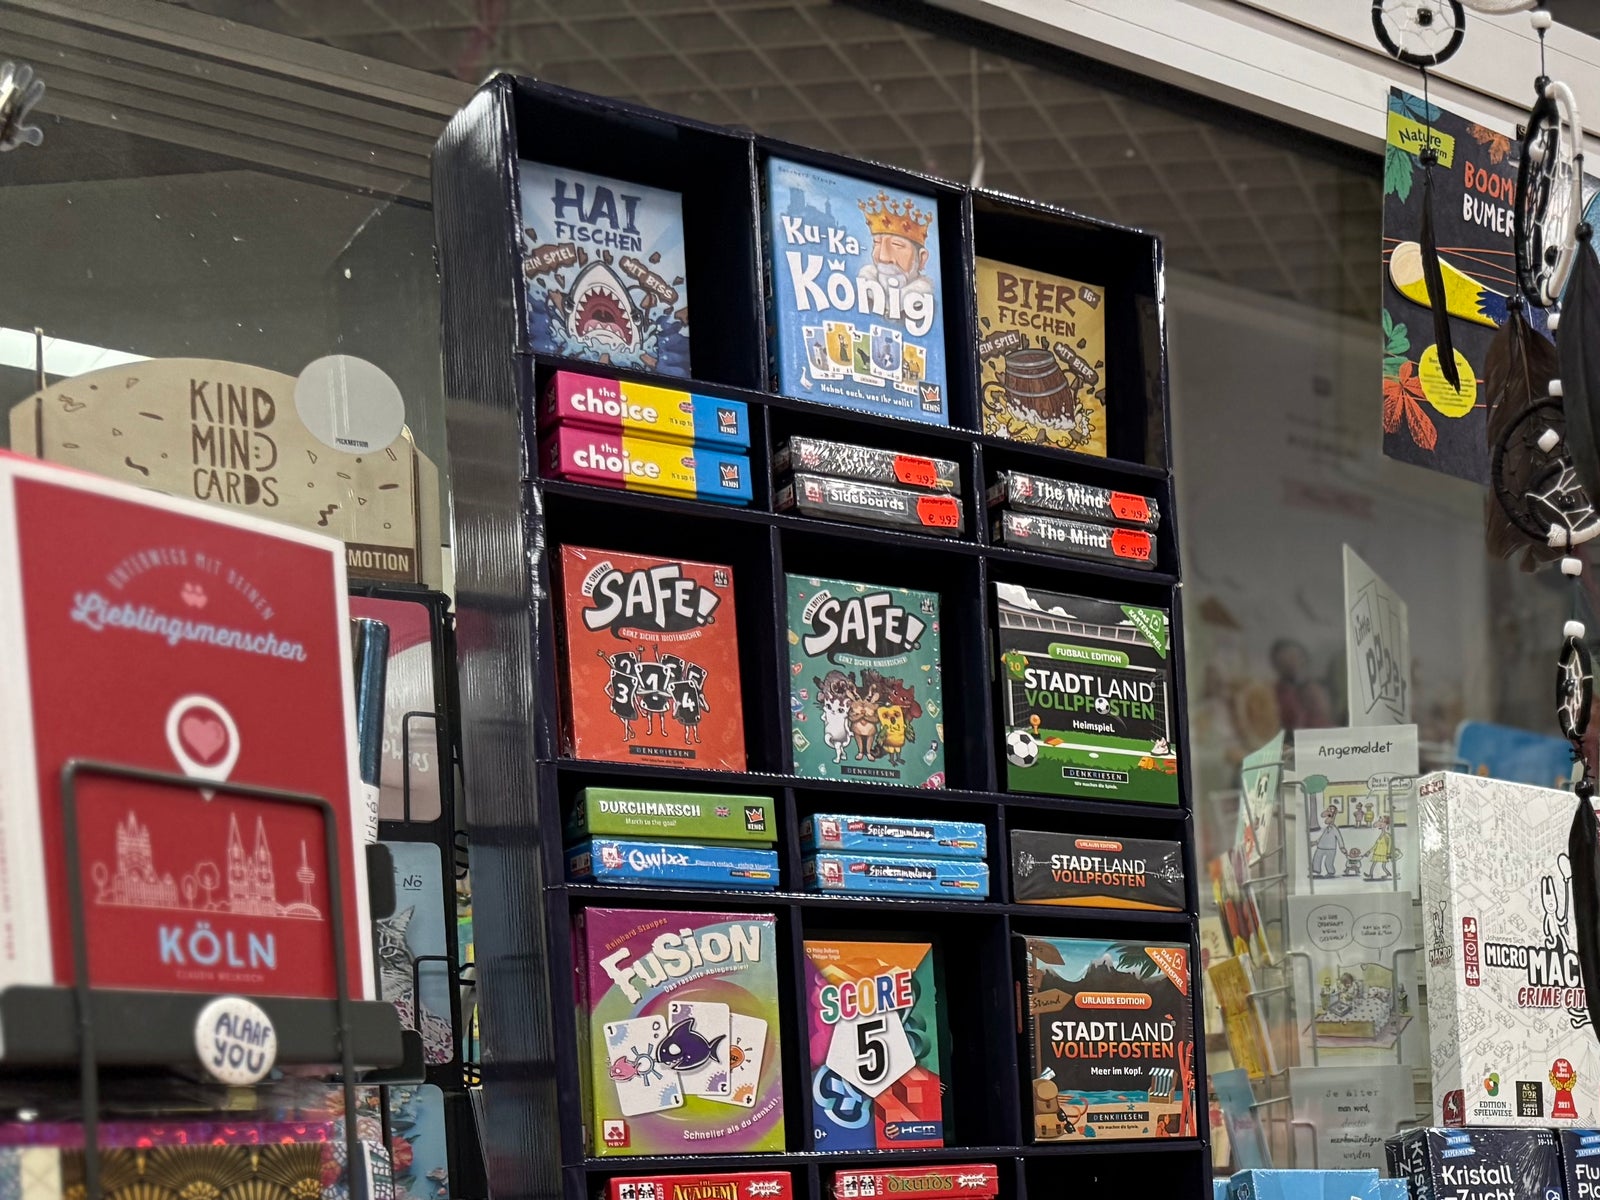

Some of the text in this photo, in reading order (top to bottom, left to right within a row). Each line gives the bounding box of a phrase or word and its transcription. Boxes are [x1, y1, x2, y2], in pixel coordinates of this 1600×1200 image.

[552, 178, 642, 236] HAI
[554, 221, 642, 251] FISCHEN
[781, 215, 867, 256] Ku-Ka-
[525, 247, 575, 272] EIN SPIEL
[622, 257, 673, 300] MIT BISS
[786, 251, 934, 337] König
[996, 272, 1076, 317] BIER
[999, 306, 1076, 337] FISCHEN
[979, 334, 1019, 354] EIN SPIEL
[1055, 343, 1095, 379] MIT BIER
[190, 379, 275, 429] KIND
[599, 387, 616, 398] the
[821, 383, 913, 409] Nehmt euch, was ihr wollt!
[570, 389, 659, 423] choice
[194, 468, 279, 507] CARDS
[831, 490, 905, 511] Sideboards
[1038, 523, 1107, 548] The Mind
[107, 549, 274, 621] UNTERWEGS MIT DEINEN
[583, 564, 721, 632] SAFE!
[70, 591, 307, 662] Lieblingsmenschen
[1091, 651, 1122, 664] EDITION
[1024, 668, 1155, 702] STADT LAND
[1318, 740, 1393, 760] Angemeldet
[1069, 769, 1123, 782] DENKRIESEN
[599, 799, 701, 818] DURCHMARSCH
[629, 847, 689, 870] Qwixx
[158, 922, 276, 970] KÖLN
[605, 930, 637, 951] Reinhard
[1485, 943, 1527, 969] MICRO
[820, 968, 913, 1024] SCORE
[1518, 987, 1559, 1008] CRIME
[215, 1012, 271, 1044] ALAAF
[1051, 1021, 1173, 1042] STADT LAND
[214, 1041, 265, 1073] YOU
[855, 1018, 886, 1087] 5
[1052, 1042, 1173, 1059] VOLLPFOSTEN
[1091, 1067, 1143, 1077] Meer im Kopf.
[1093, 1113, 1143, 1121] DENKRIESEN
[1474, 1107, 1513, 1118] SPIELWIESE
[1479, 1101, 1507, 1110] EDITION
[683, 1117, 751, 1141] Schneller als du
[1441, 1163, 1514, 1190] Kristall
